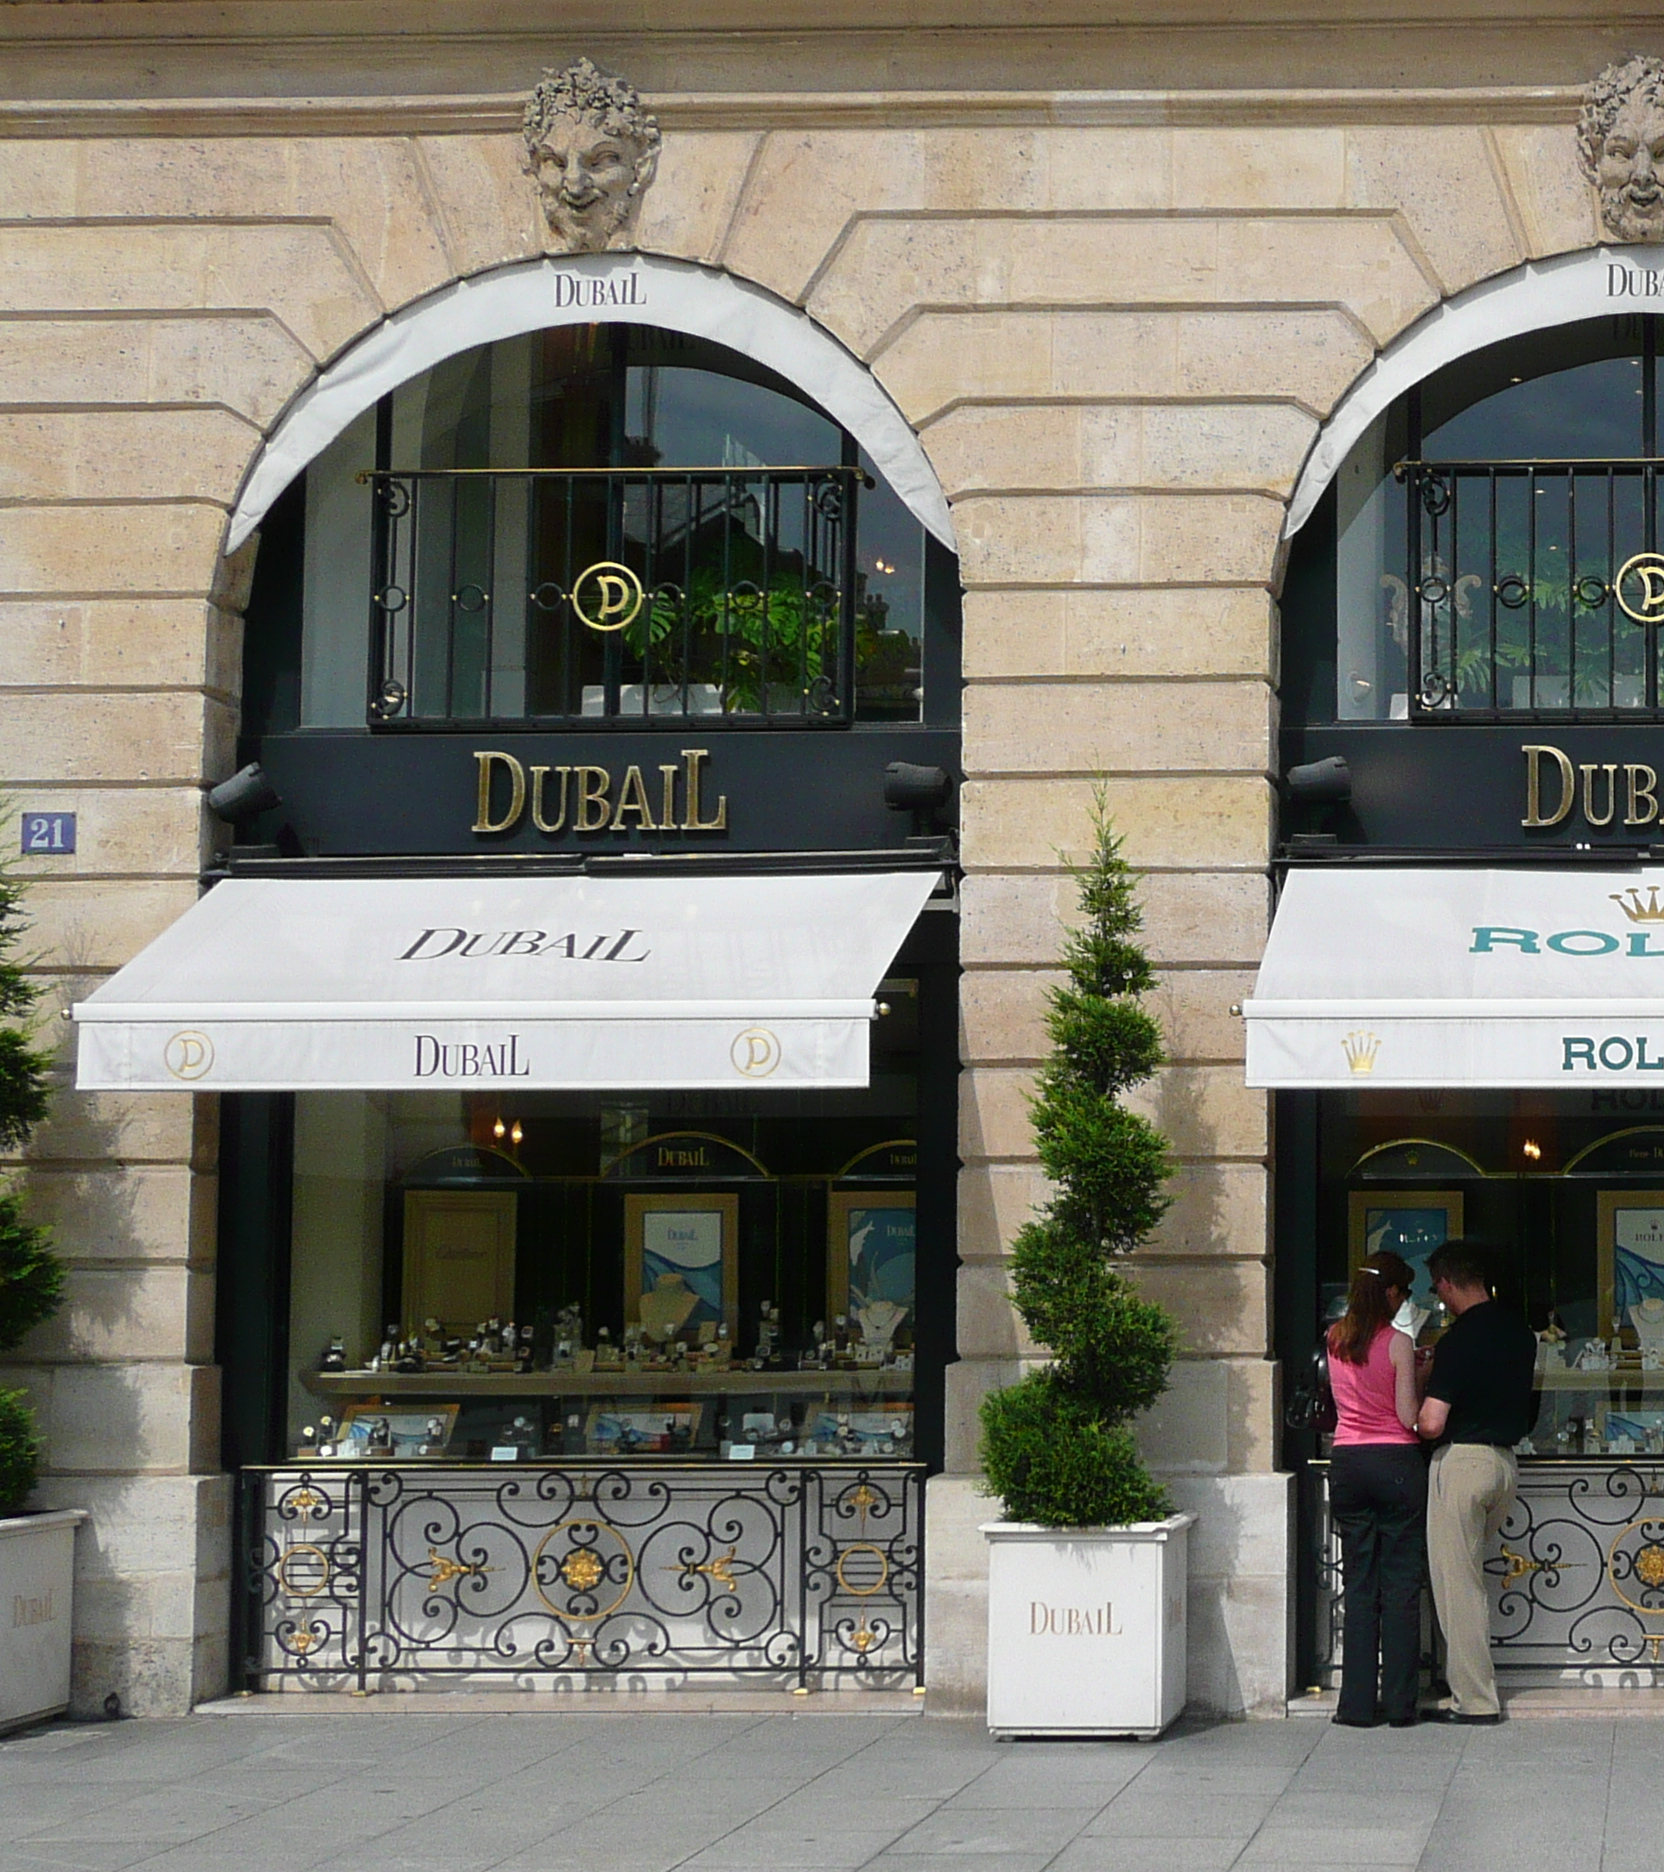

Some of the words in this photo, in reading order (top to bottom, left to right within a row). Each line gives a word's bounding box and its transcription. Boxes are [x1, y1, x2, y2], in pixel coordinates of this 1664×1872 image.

[554, 272, 647, 307] DUBAIL
[472, 749, 726, 833] DUBAIL
[29, 817, 66, 848] 21
[397, 928, 652, 962] DUBAIL
[414, 1034, 530, 1077] DUBAIL
[657, 1147, 709, 1168] DUBAIL
[1030, 1601, 1123, 1635] DUBAIL
